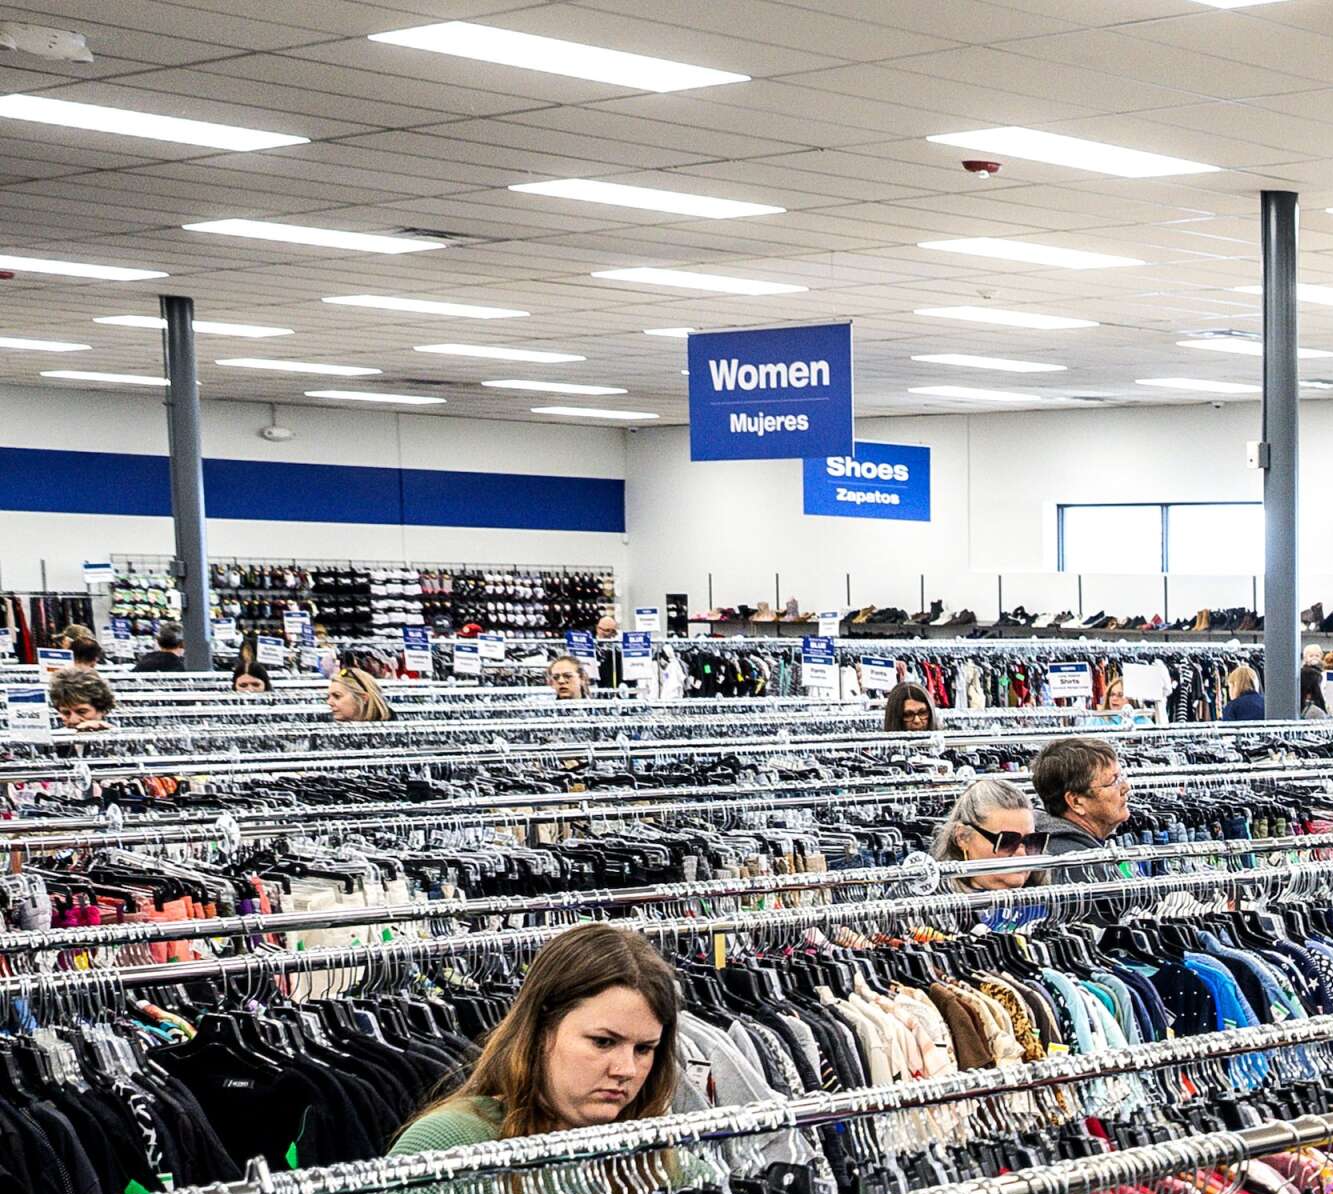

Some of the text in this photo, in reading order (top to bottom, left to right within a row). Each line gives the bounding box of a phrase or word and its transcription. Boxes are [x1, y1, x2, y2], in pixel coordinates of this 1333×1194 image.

[708, 358, 830, 391] Women
[730, 412, 809, 436] Mujeres
[826, 456, 910, 481] Shoes
[836, 488, 900, 505] Zapatos
